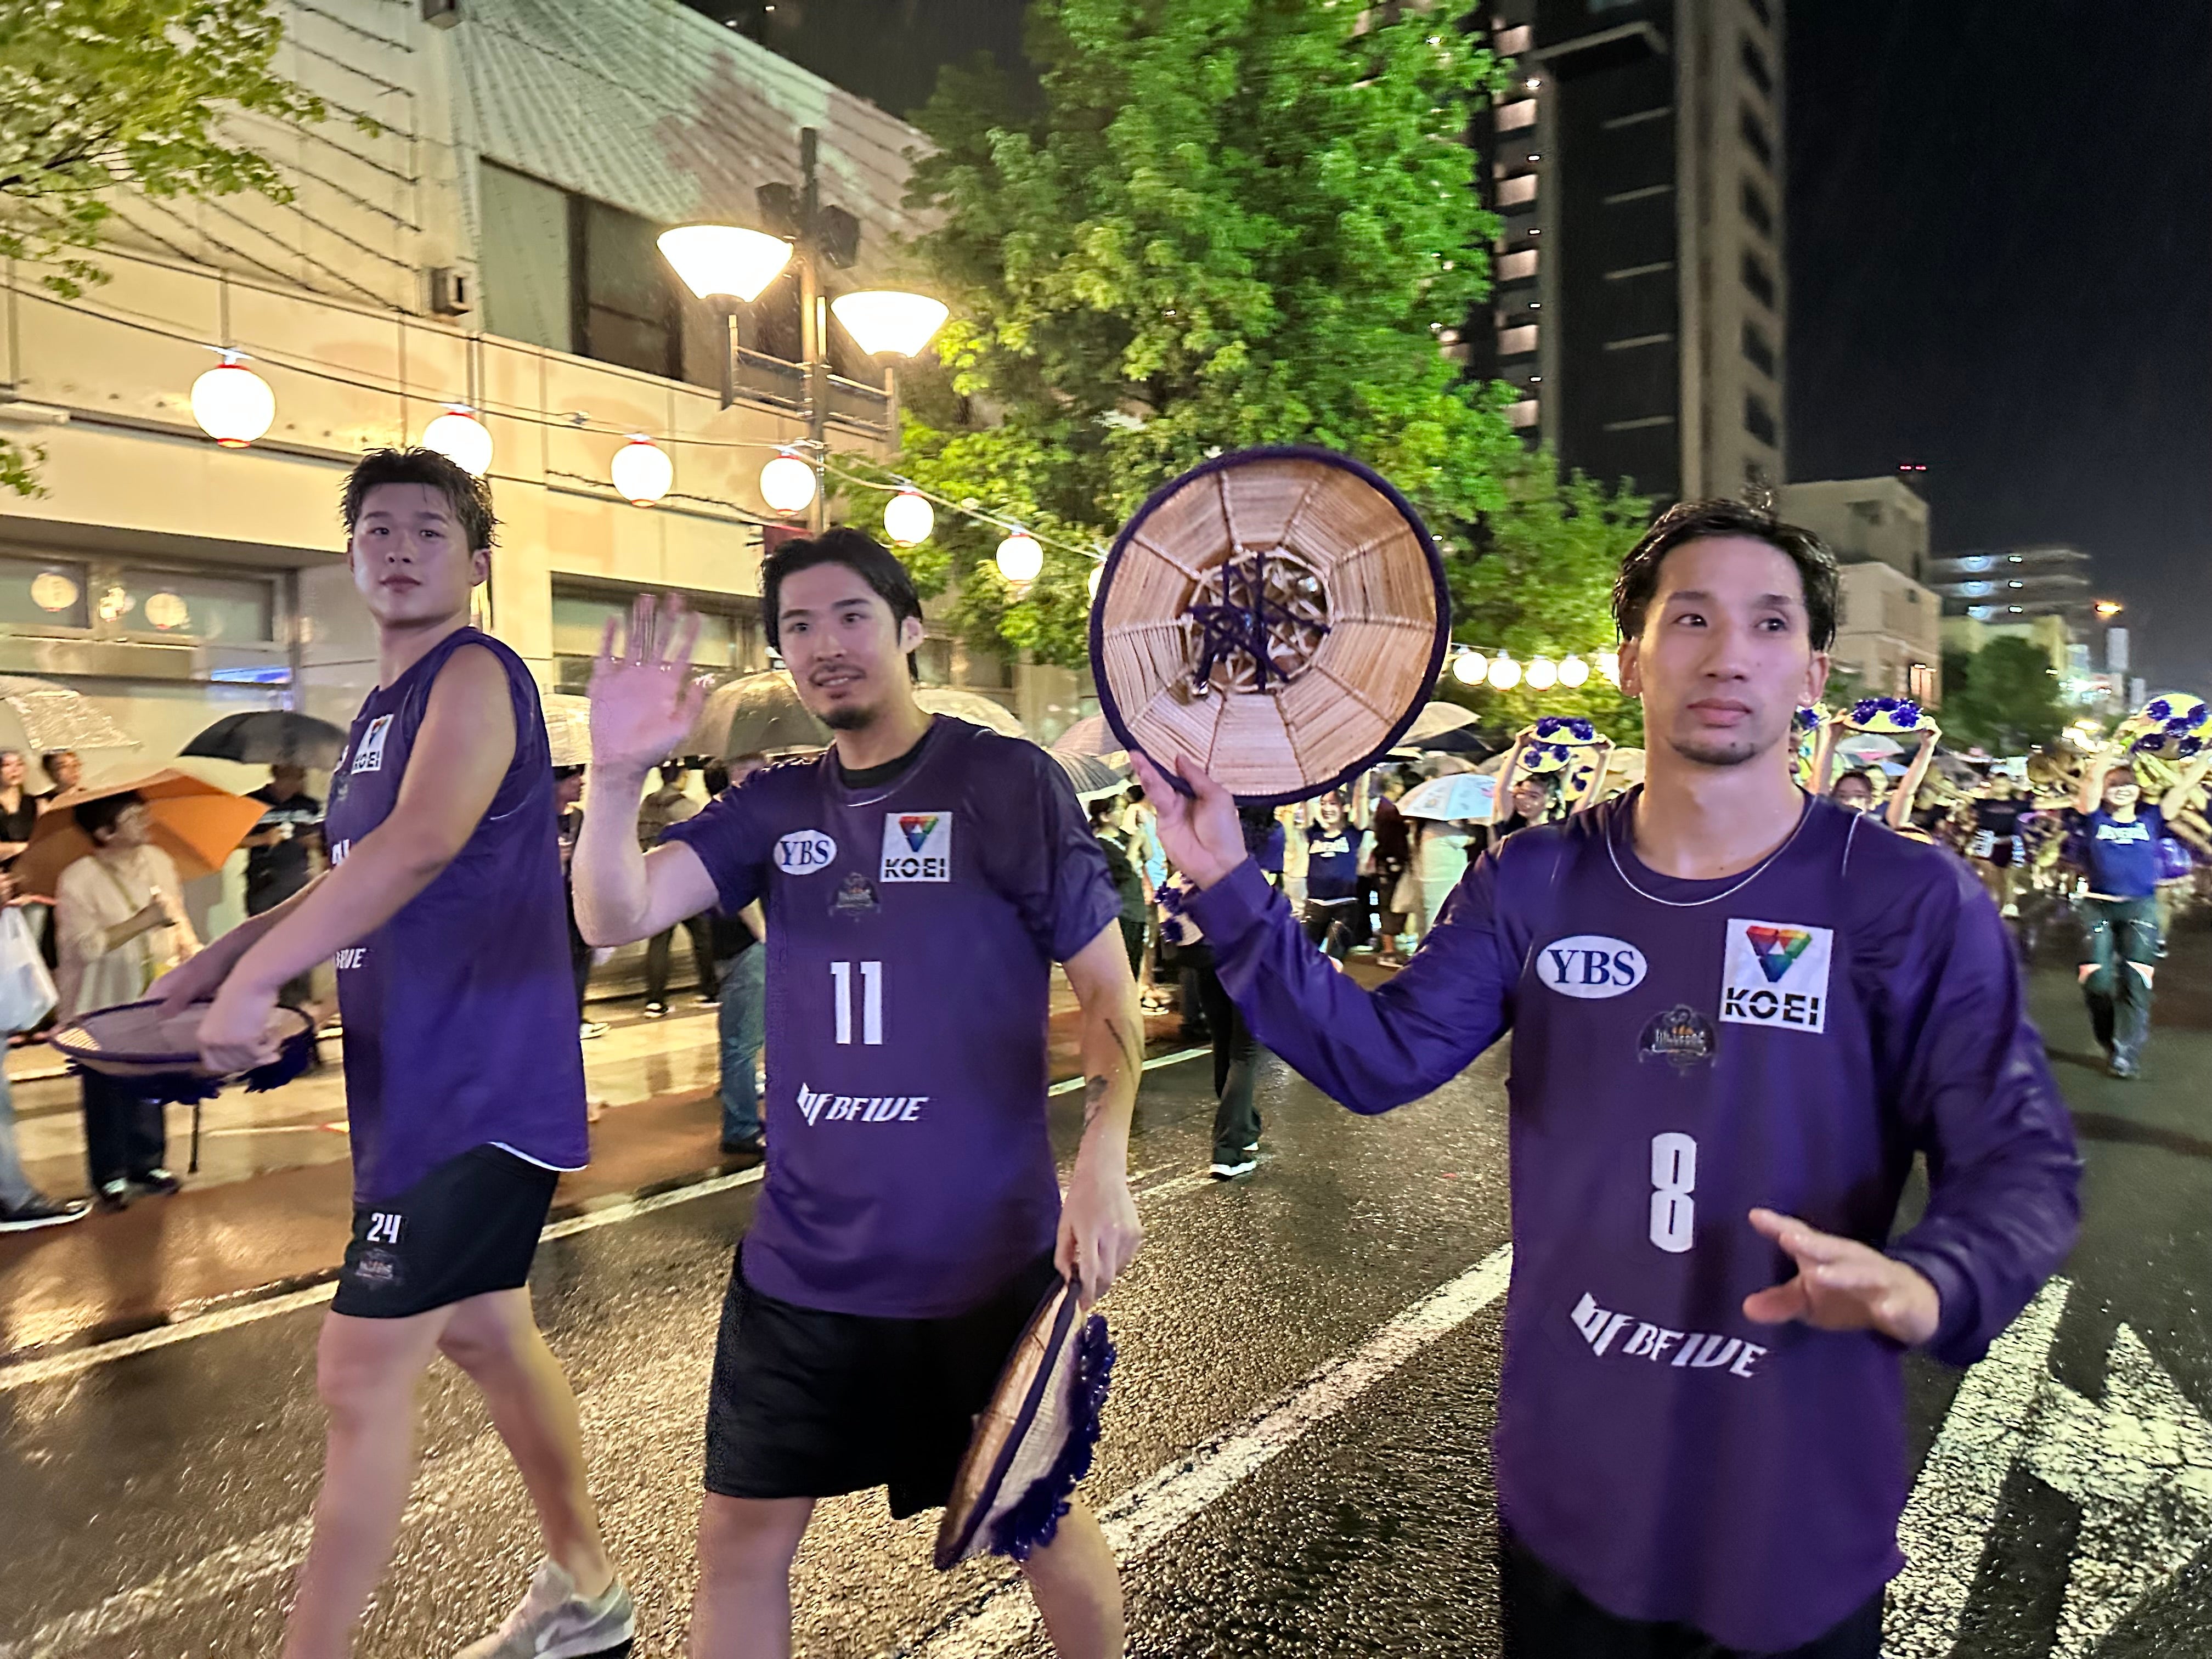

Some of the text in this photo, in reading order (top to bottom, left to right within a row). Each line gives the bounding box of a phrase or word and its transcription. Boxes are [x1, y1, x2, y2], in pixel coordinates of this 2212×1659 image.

[781, 839, 829, 866] YBS
[885, 857, 945, 878] KOEI
[1548, 949, 1636, 987] YBS
[831, 961, 883, 1045] 11
[1724, 987, 1819, 1026] KOEI
[825, 1096, 929, 1121] BFIVE
[1650, 1132, 1697, 1252] 8
[366, 1212, 402, 1244] 24
[1622, 1322, 1767, 1378] BFIVE
